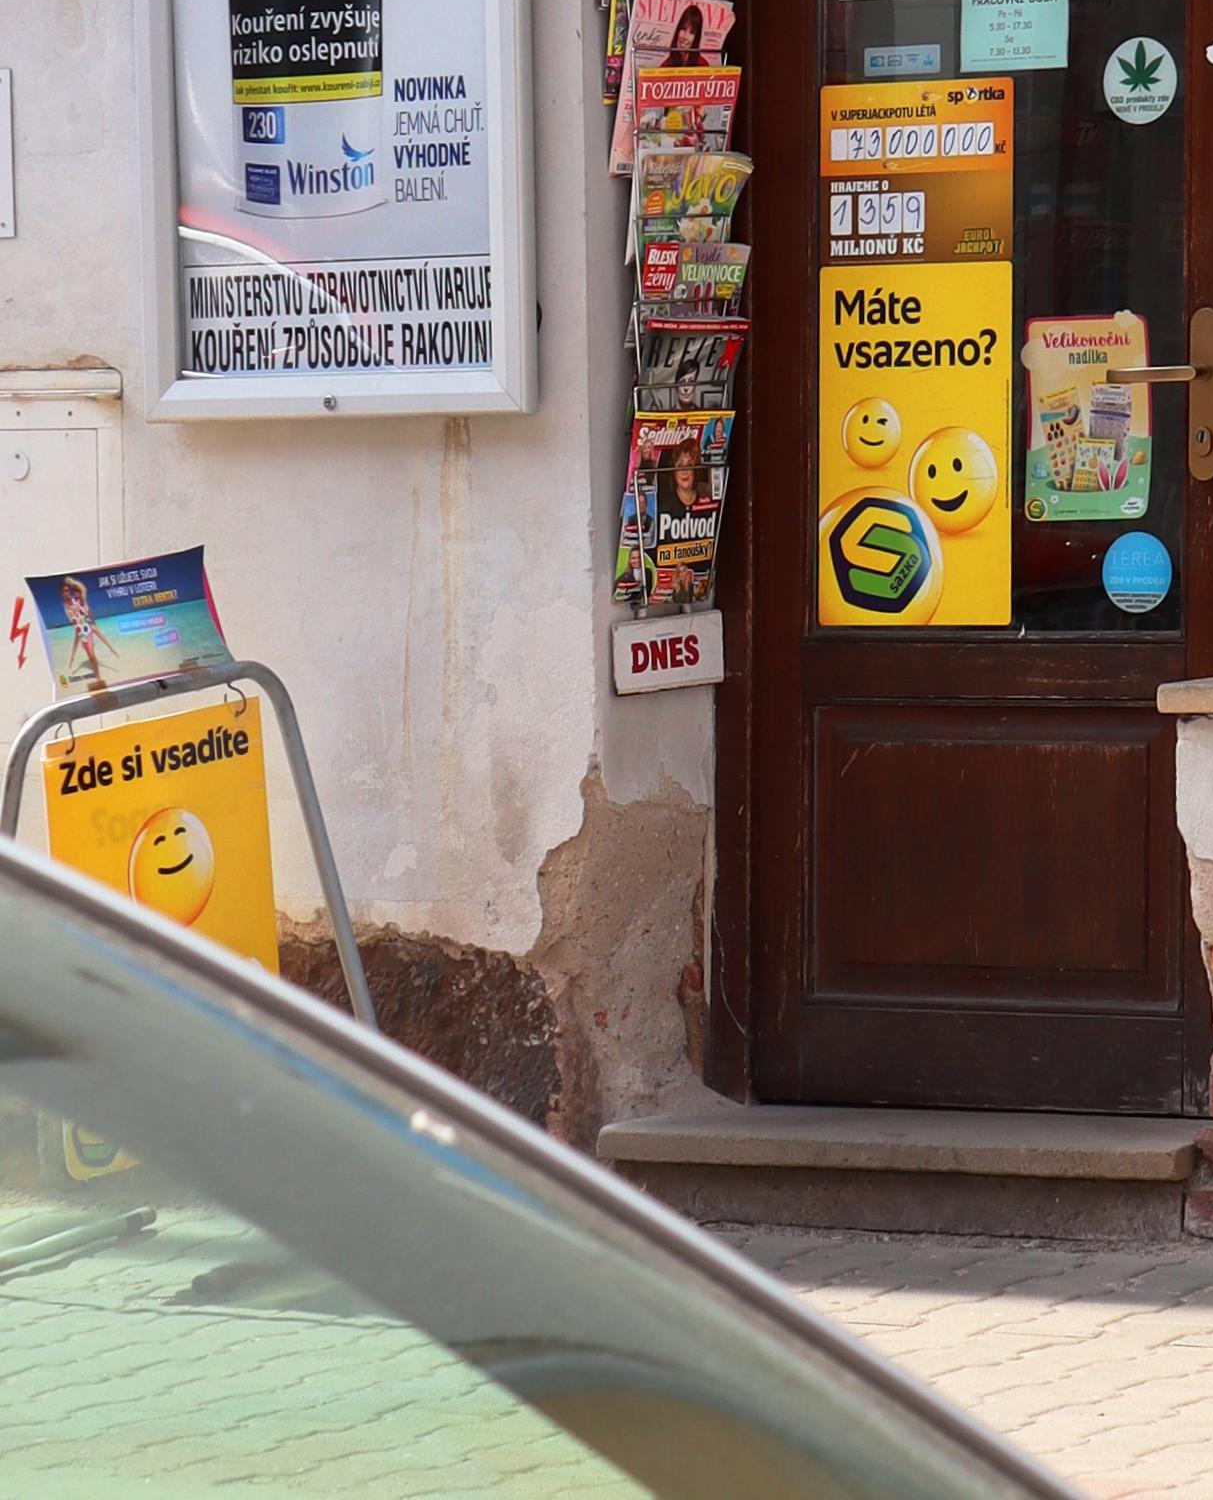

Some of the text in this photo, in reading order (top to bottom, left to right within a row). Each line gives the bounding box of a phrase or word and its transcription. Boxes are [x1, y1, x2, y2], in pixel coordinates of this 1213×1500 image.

[231, 3, 380, 36] Kouření zvyšuje
[232, 33, 380, 67] riziko oslepnutí
[394, 75, 466, 102] NOVINKA
[640, 76, 735, 100] rozmarýna
[248, 111, 276, 139] 230
[393, 101, 484, 136] JEMNÁ CHUŤ.
[831, 104, 936, 121] V SUPERJACKPOTU LÉTÁ
[393, 135, 471, 169] VÝHODNÉ
[287, 159, 375, 195] Winston
[395, 170, 448, 202] BALENÍ.
[831, 180, 889, 193] HRAJEME O
[830, 234, 924, 256] MILIONŮ KČ
[954, 240, 1002, 255] JACKPOT
[964, 229, 993, 241] EURO
[647, 249, 678, 265] BLESK
[682, 264, 743, 283] VELIKONOCE
[190, 262, 491, 319] MINISTERSTVO ZDRAVOTNICTVÍ VARUJE
[833, 288, 921, 326] Máte
[191, 322, 278, 373] KOUŘENÍ
[283, 319, 394, 370] ZPŮSOBUJE
[834, 329, 997, 369] vsazeno?
[1042, 332, 1131, 350] Velikonoční
[1068, 350, 1108, 365] nadílka
[659, 511, 715, 540] Podvod
[659, 548, 671, 561] na
[631, 634, 700, 674] DNES
[60, 725, 249, 795] Zde si vsadíte
